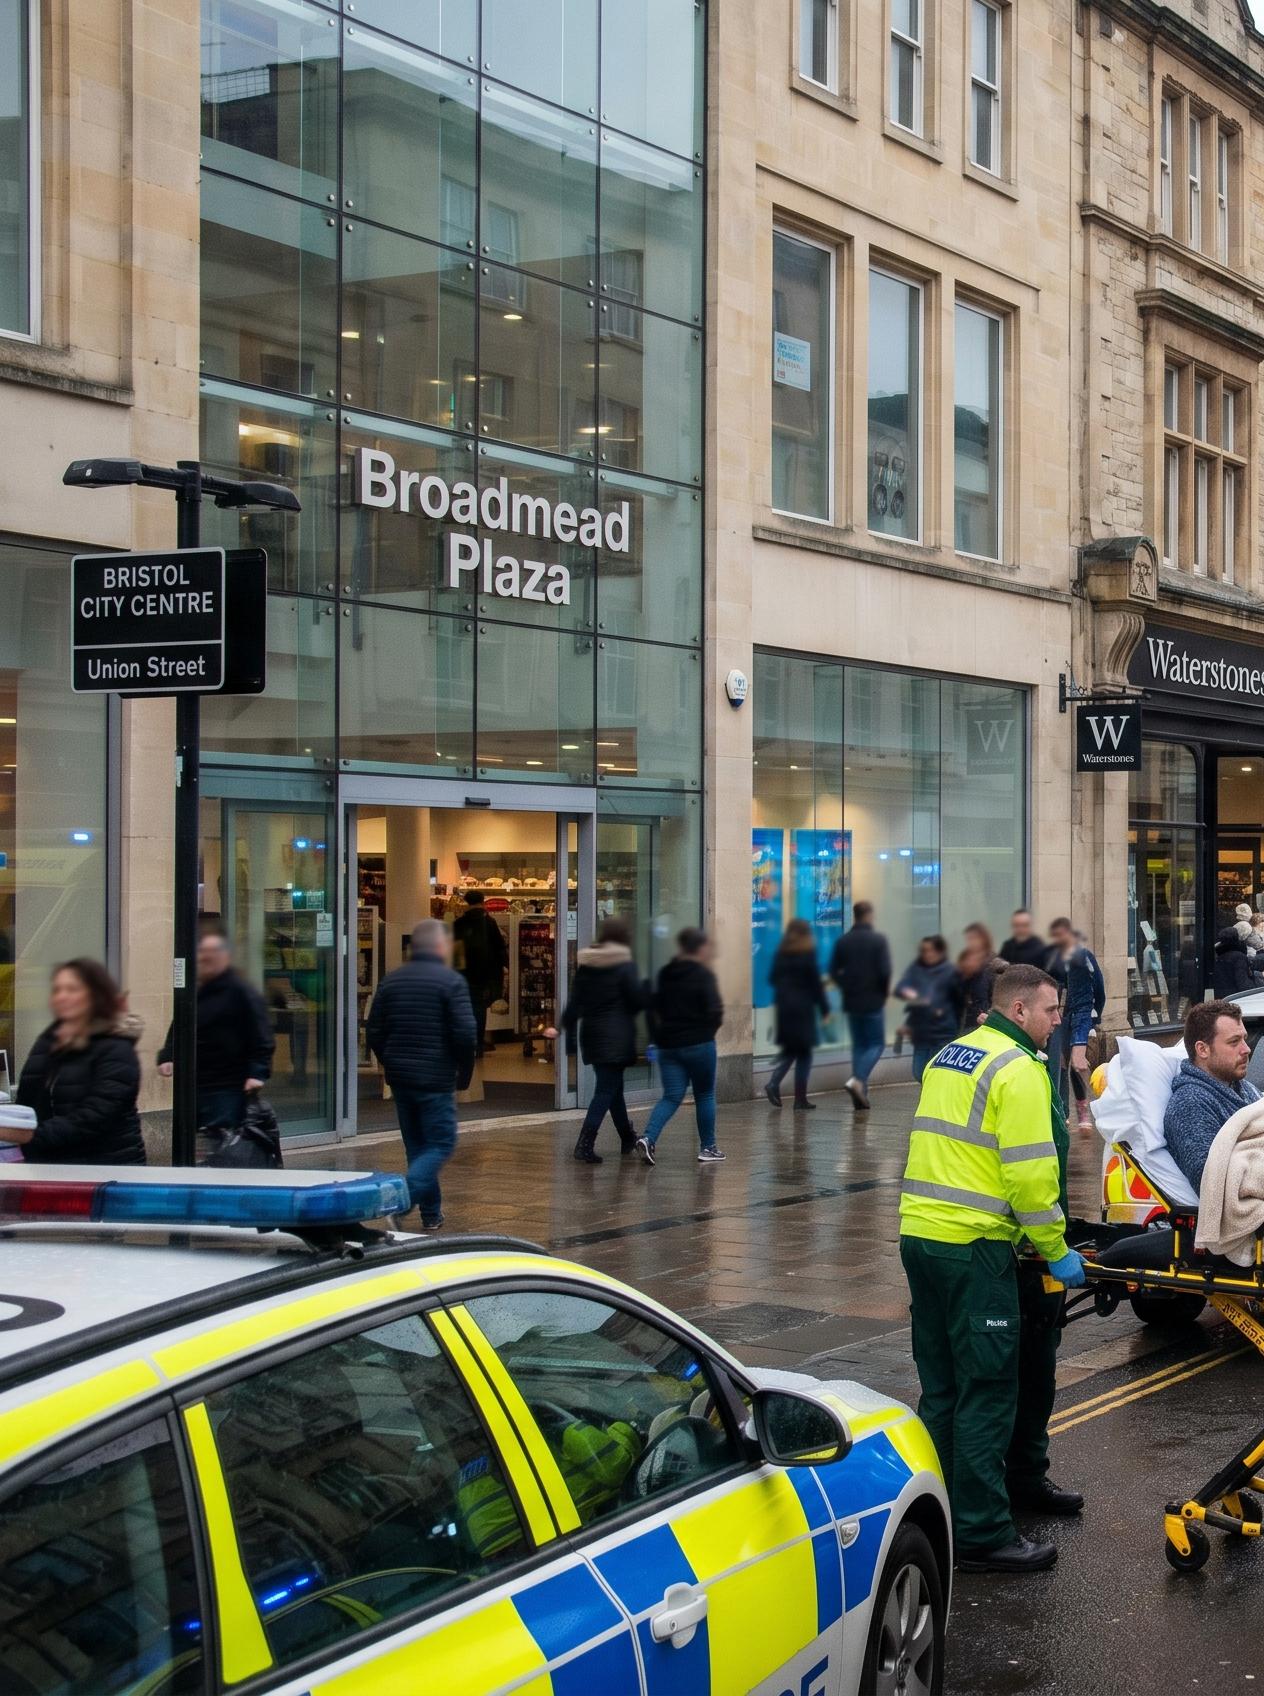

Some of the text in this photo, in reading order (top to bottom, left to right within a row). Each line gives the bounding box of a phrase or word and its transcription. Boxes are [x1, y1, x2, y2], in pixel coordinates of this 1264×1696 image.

[358, 447, 630, 553] Broadmead
[103, 564, 190, 589] BRISTOL
[447, 532, 571, 606] Plaza
[80, 591, 214, 619] CITY CENTRE
[88, 655, 206, 680] Union Street
[1085, 715, 1130, 751] W
[1082, 753, 1135, 763] Waterstones
